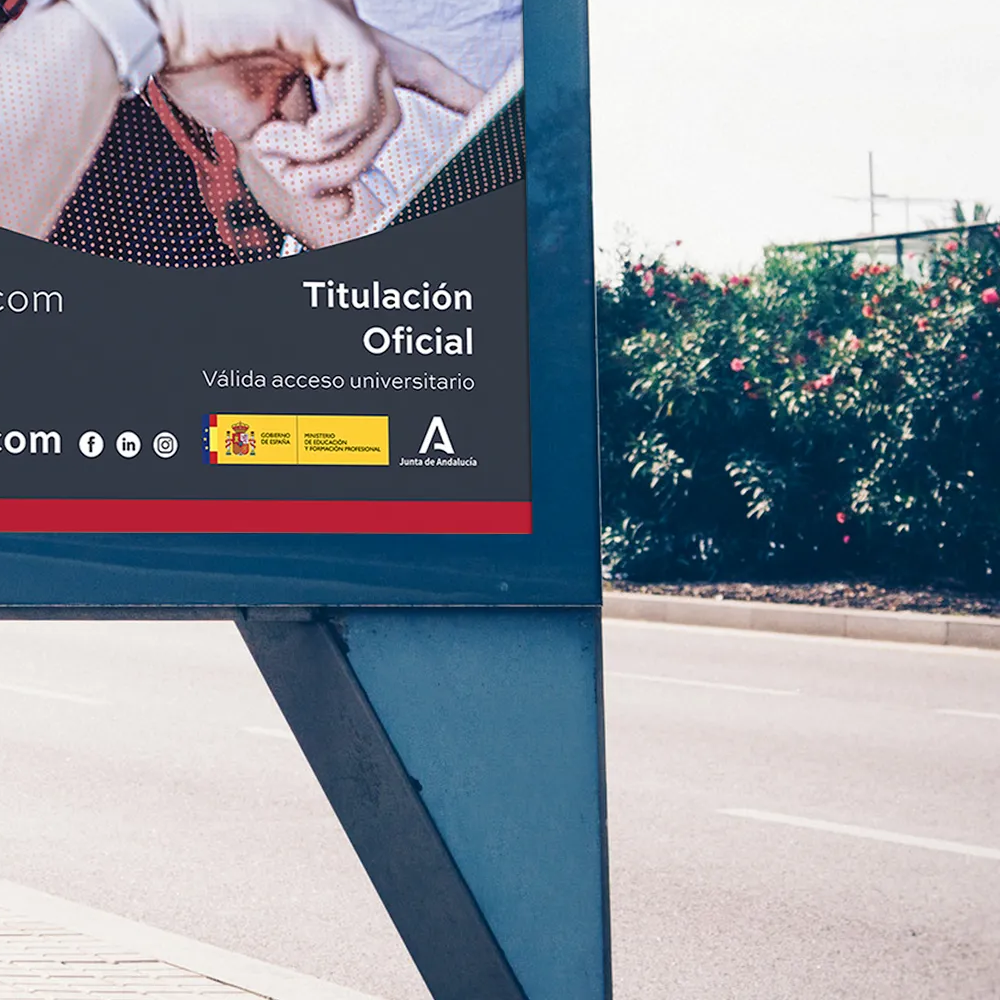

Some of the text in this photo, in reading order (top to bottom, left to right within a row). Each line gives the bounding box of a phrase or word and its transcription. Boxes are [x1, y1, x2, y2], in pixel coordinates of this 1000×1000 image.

[302, 279, 473, 311] Titulación
[363, 326, 474, 355] Oficial
[202, 370, 475, 391] Válida acceso universitario
[399, 456, 477, 467] Junta de Andalucía
